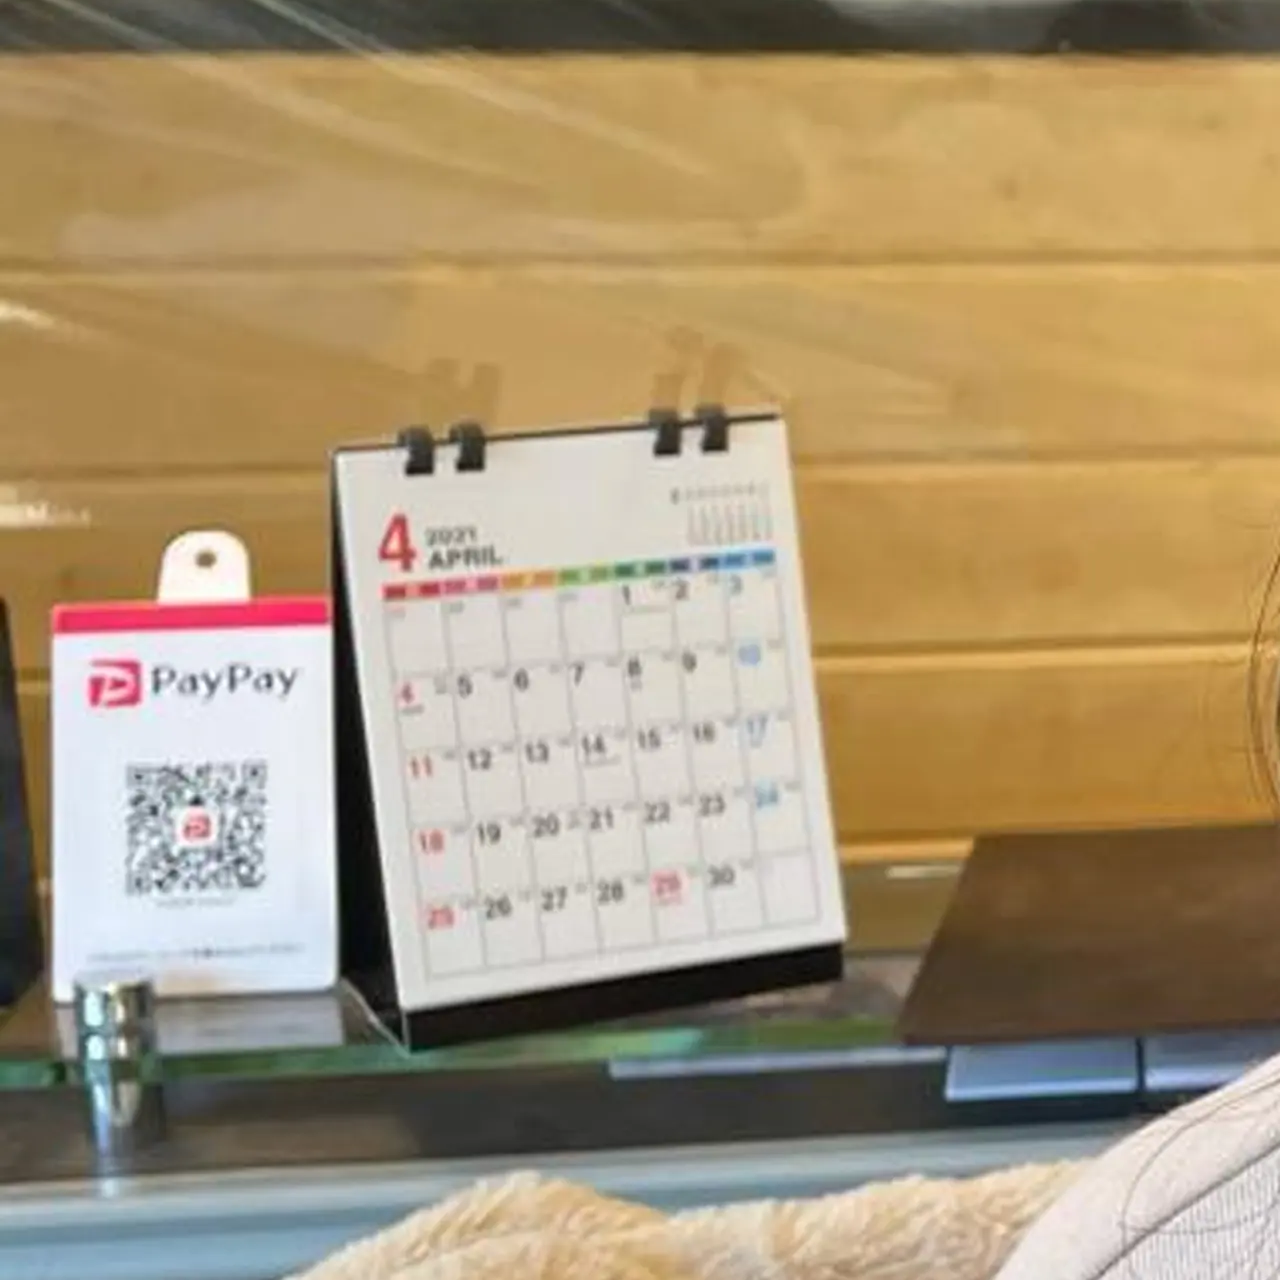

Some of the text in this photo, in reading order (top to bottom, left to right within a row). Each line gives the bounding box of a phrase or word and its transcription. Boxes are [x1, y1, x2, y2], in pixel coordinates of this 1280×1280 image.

[379, 512, 416, 572] 4
[425, 525, 478, 547] 2021
[427, 545, 503, 570] APRIL
[152, 661, 298, 702] PayPay
[410, 754, 434, 779] 11
[468, 746, 492, 771] 12
[525, 739, 549, 764] 13
[581, 732, 606, 756] 14
[637, 726, 662, 750] 15
[692, 721, 716, 744] 16
[477, 820, 502, 847] 19
[532, 812, 560, 839] 20
[589, 804, 614, 831] 21
[644, 799, 671, 825] 22
[699, 791, 726, 817] 23
[484, 893, 513, 921] 26
[541, 884, 568, 912] 27
[597, 877, 625, 904] 28
[707, 864, 736, 889] 30
